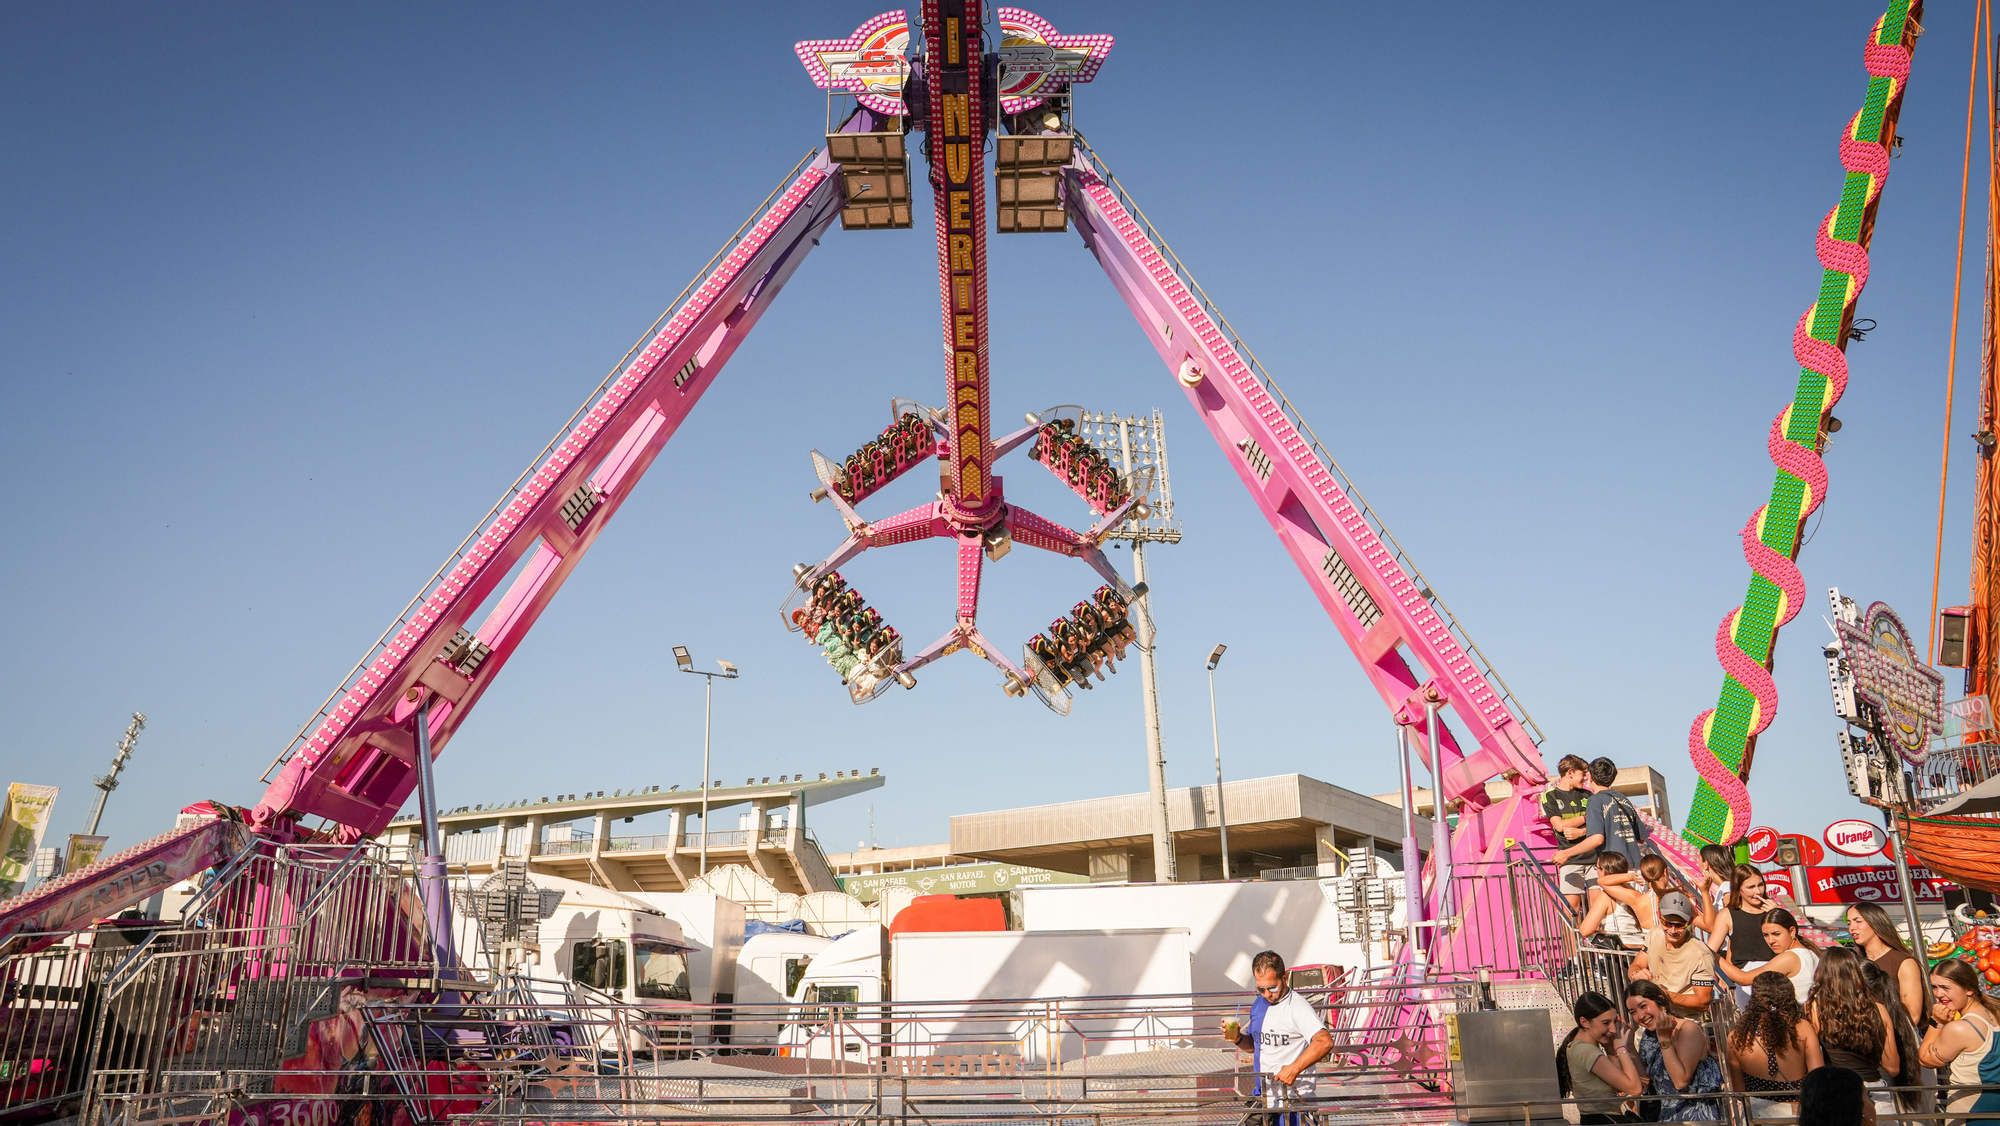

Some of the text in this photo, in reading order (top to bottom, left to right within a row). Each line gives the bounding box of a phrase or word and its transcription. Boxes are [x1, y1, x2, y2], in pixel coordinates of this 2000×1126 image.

[15, 795, 51, 806] SUPER
[1836, 829, 1873, 846] Uranga
[76, 843, 103, 852] SUPER
[1749, 834, 1771, 856] Uranga
[940, 870, 986, 882] SAN RAFAEL
[1010, 866, 1027, 876] SAN
[863, 877, 908, 888] SAN RAFAEL
[1020, 873, 1051, 884] MOTOR
[949, 880, 977, 890] MOTOR
[875, 1055, 1019, 1085] INVERTER
